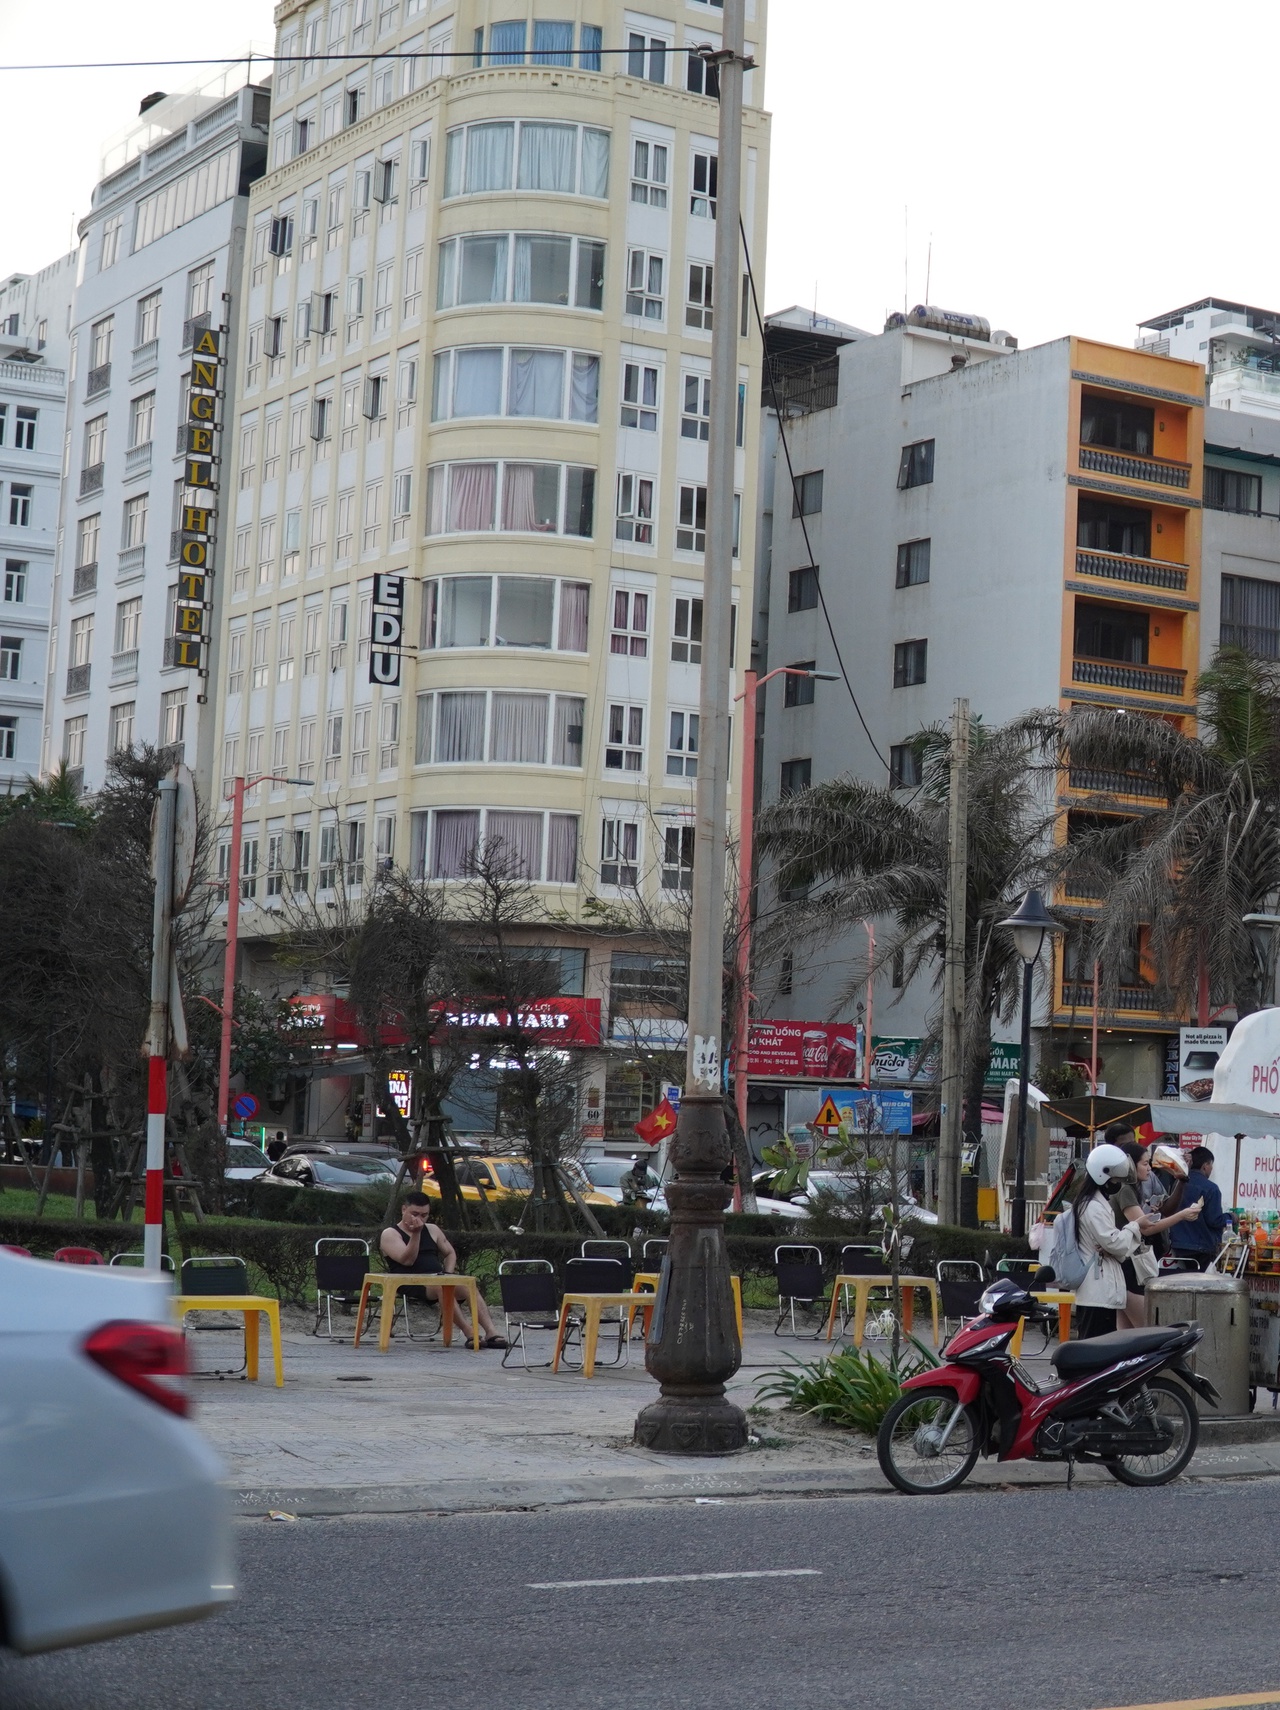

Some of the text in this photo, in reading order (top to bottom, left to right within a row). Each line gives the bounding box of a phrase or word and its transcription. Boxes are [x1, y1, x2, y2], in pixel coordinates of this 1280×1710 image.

[188, 331, 217, 486] ANGEL
[177, 507, 209, 666] HOTEL
[373, 574, 400, 683] EDU
[759, 1037, 783, 1046] KHÁT
[775, 1026, 801, 1037] UỐNG
[990, 1057, 1021, 1070] MAR
[1163, 1039, 1180, 1094] ZENTA
[1252, 1056, 1280, 1094] PHỐ
[587, 1110, 599, 1119] 60
[1239, 1179, 1266, 1201] QUẬN
